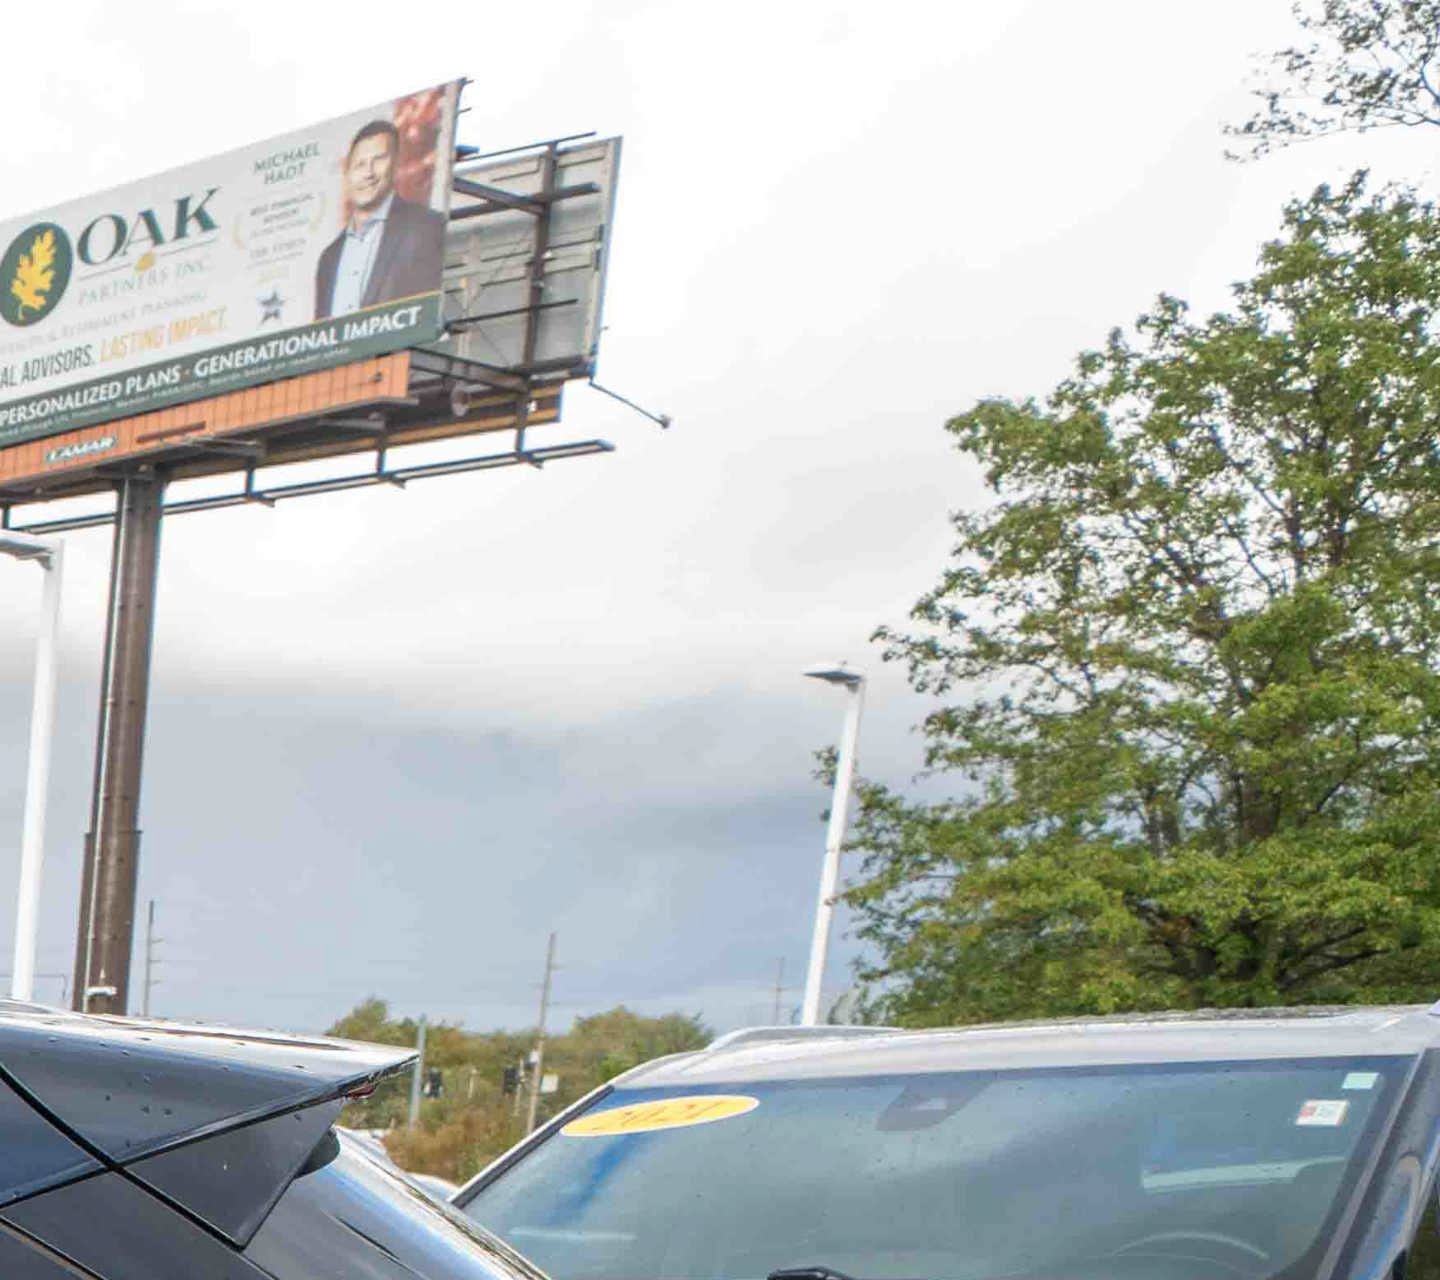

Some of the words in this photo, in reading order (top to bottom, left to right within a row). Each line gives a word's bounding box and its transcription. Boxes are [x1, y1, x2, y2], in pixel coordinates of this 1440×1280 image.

[254, 142, 320, 174] MICHAEL
[78, 187, 220, 265] OAK
[21, 345, 95, 384] ADVISORS.
[100, 325, 164, 363] LASTING
[126, 365, 181, 397] PLANS
[194, 331, 338, 377] GENERATIONAL
[343, 305, 423, 345] IMPACT
